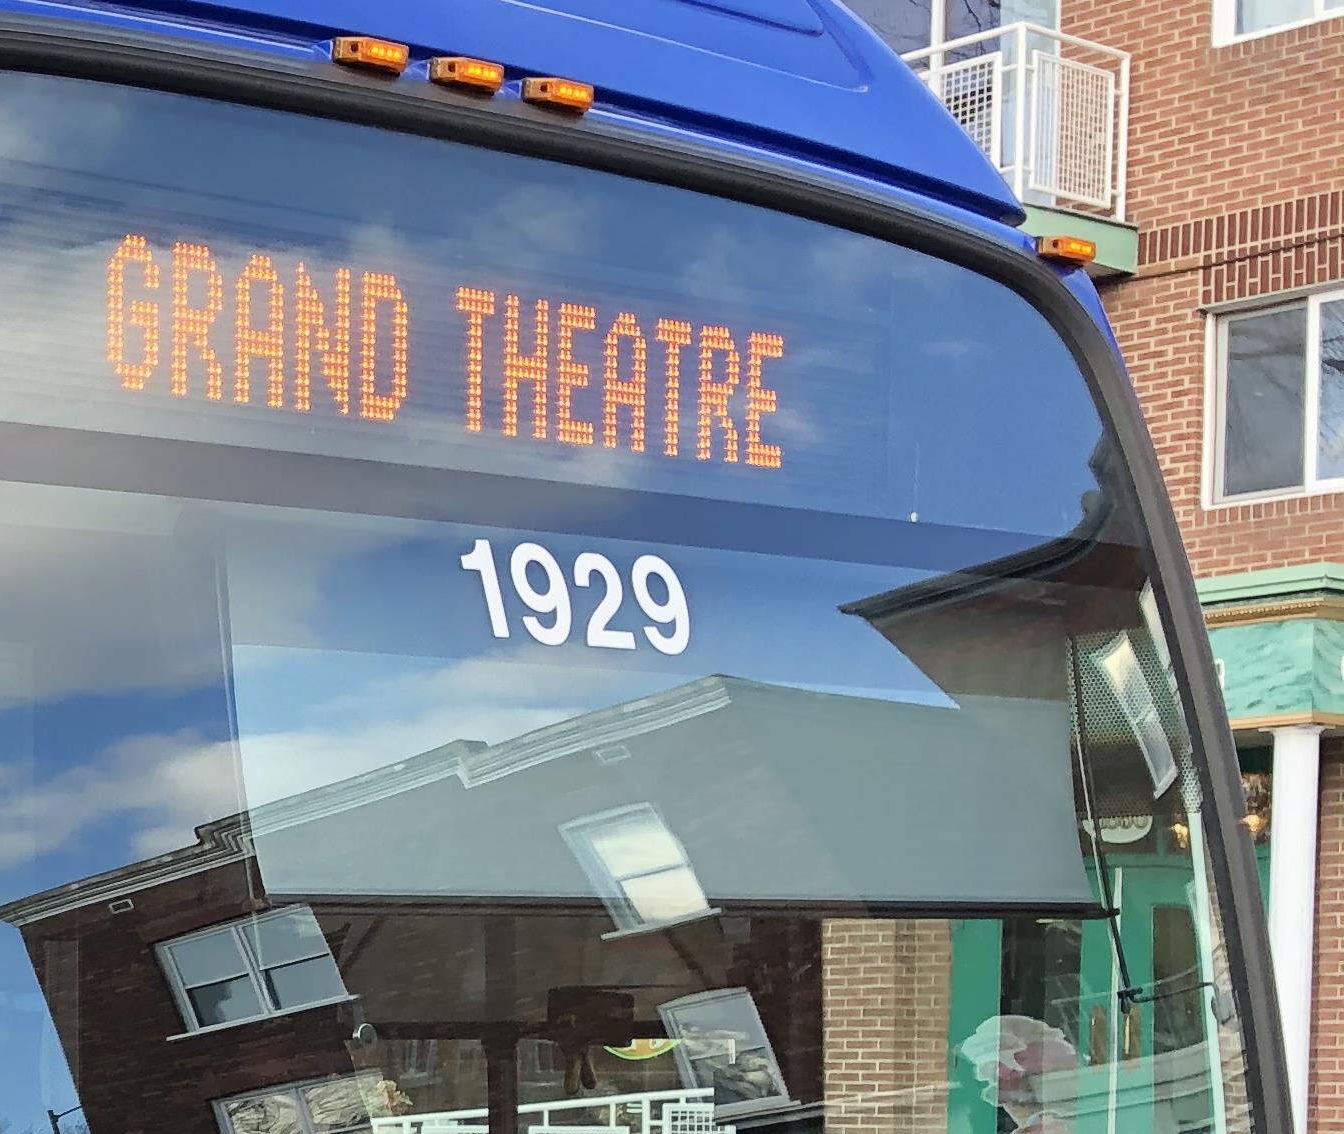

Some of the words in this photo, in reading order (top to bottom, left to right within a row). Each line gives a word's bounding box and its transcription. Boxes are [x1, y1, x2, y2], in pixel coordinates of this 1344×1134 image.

[106, 232, 408, 423] GRAND
[455, 285, 784, 468] THEATRE
[458, 538, 691, 656] 1929
